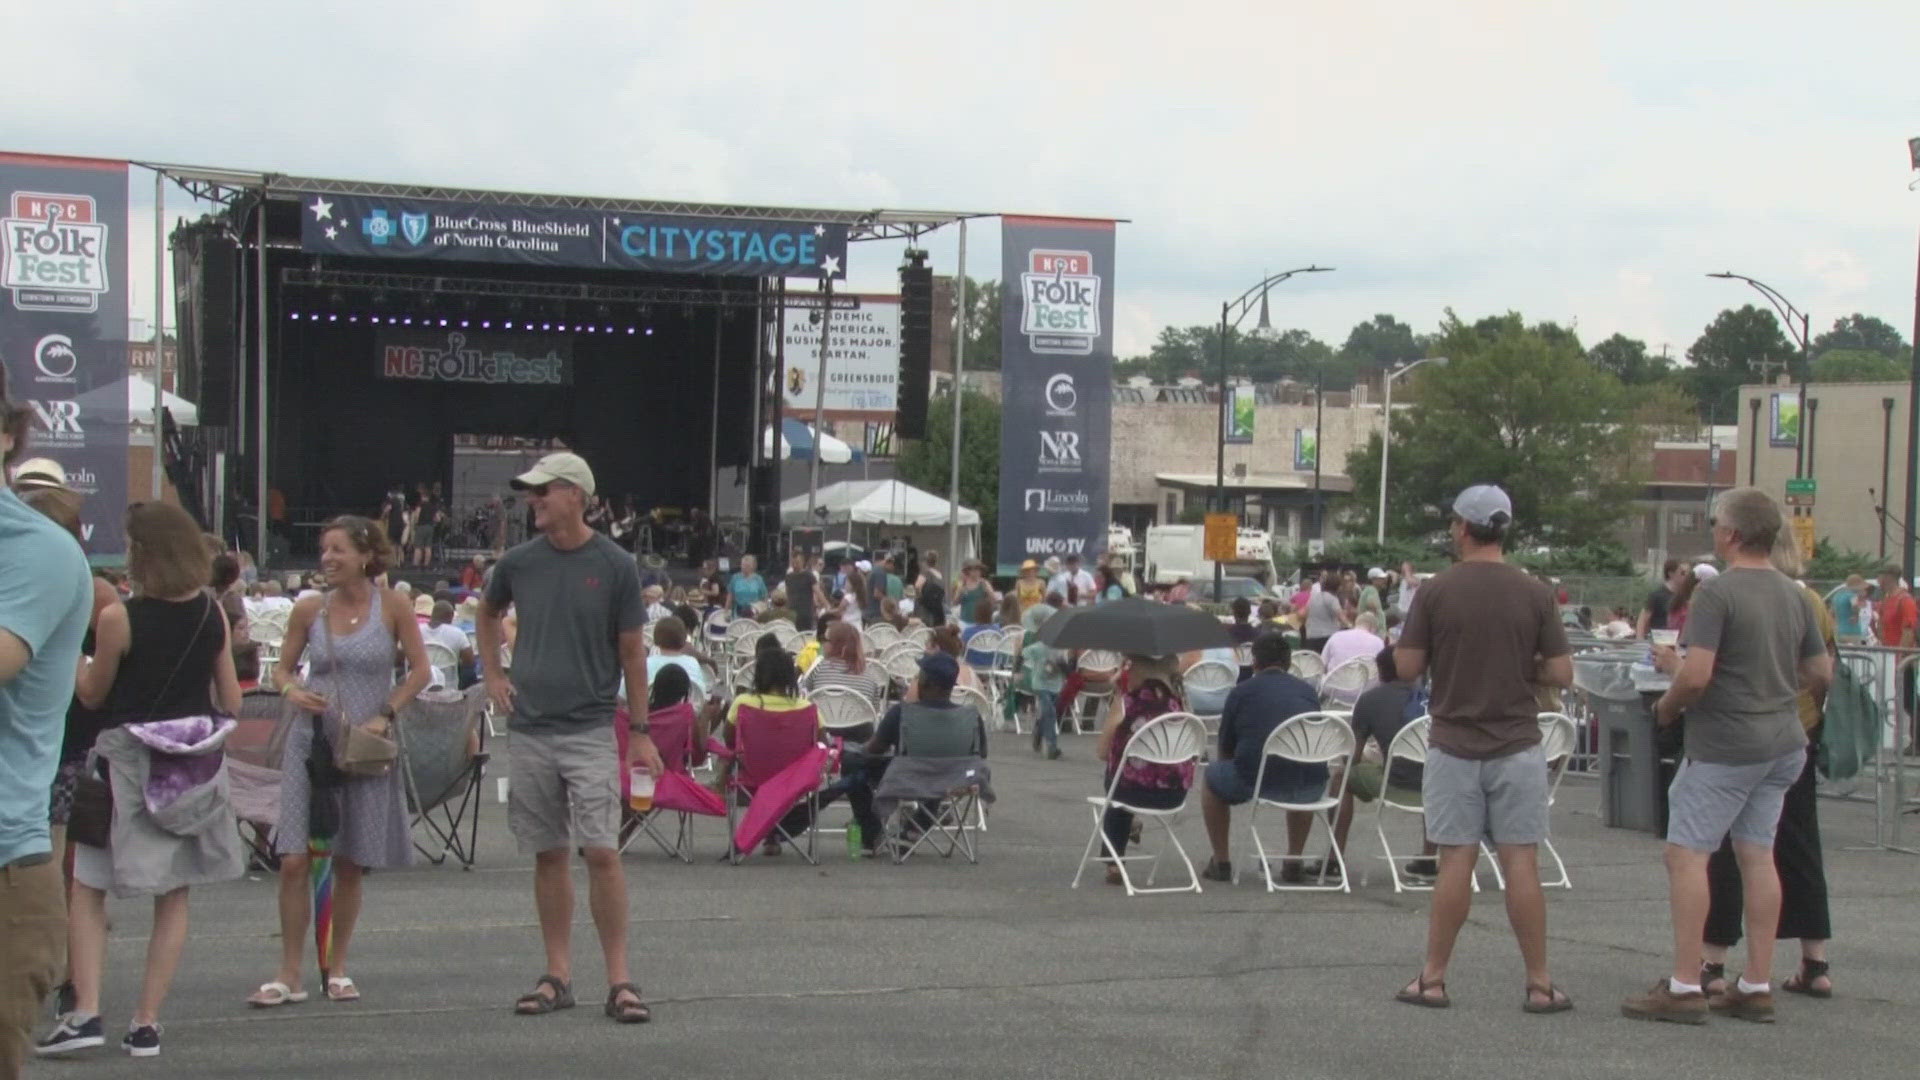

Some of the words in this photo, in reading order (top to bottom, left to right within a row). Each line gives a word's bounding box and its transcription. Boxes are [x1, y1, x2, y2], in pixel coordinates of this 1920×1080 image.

[434, 215, 507, 232] BlueCross
[511, 219, 590, 237] BlueShield
[14, 226, 95, 258] Folk
[434, 233, 448, 246] of
[452, 233, 493, 248] North
[497, 235, 559, 252] Carolina
[620, 225, 816, 265] CITYSTAGE
[17, 255, 92, 284] Fest
[1031, 280, 1091, 306] Folk
[1034, 304, 1088, 329] Fest
[792, 323, 889, 335] ALL-MERICAN.
[786, 336, 846, 347] BUSINSS
[849, 338, 896, 348] MAJOR.
[830, 373, 895, 384] GREENSBORO
[1047, 489, 1088, 504] Lincoln
